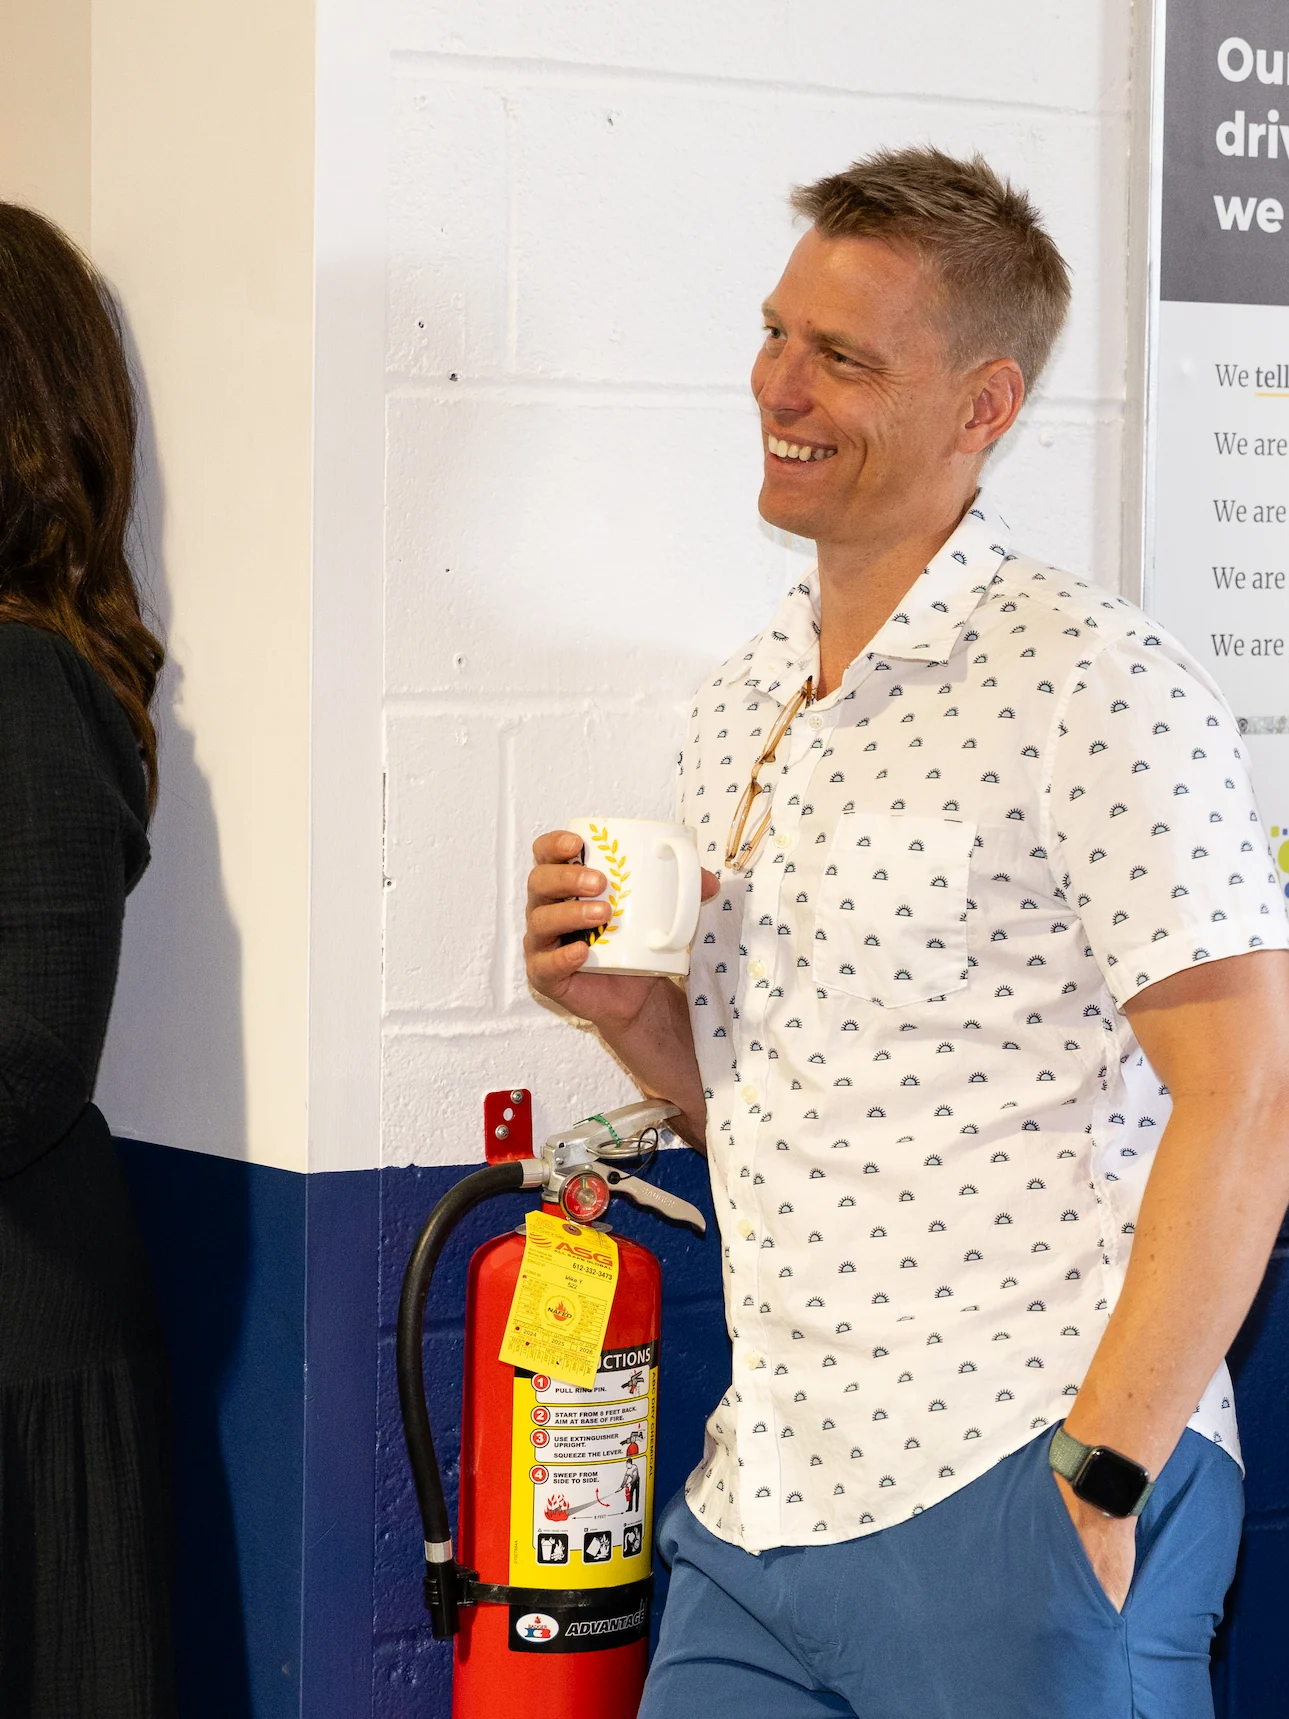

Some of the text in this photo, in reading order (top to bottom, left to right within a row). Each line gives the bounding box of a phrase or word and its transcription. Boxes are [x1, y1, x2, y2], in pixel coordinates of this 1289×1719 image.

[1213, 194, 1284, 233] we
[1215, 364, 1249, 388] We
[1255, 364, 1289, 388] tell
[1214, 432, 1248, 456] We
[1254, 437, 1288, 456] are
[1213, 500, 1247, 523] We
[1253, 504, 1287, 524] are
[1212, 566, 1246, 589] We
[1252, 570, 1286, 590] are
[1211, 633, 1245, 656] We
[1250, 637, 1284, 656] are
[556, 1242, 613, 1267] ASG
[572, 1262, 613, 1281] 612-332-3473
[547, 1307, 573, 1319] NAFED
[523, 1329, 537, 1338] 2024
[551, 1338, 565, 1347] 2025
[579, 1346, 593, 1355] 2026
[536, 1410, 545, 1420] 2
[535, 1433, 545, 1443] 3
[570, 1433, 619, 1442] EXTINGUISHER
[602, 1449, 623, 1457] LEVER.
[534, 1469, 544, 1480] 4
[565, 1609, 645, 1637] ADVANTAGE
